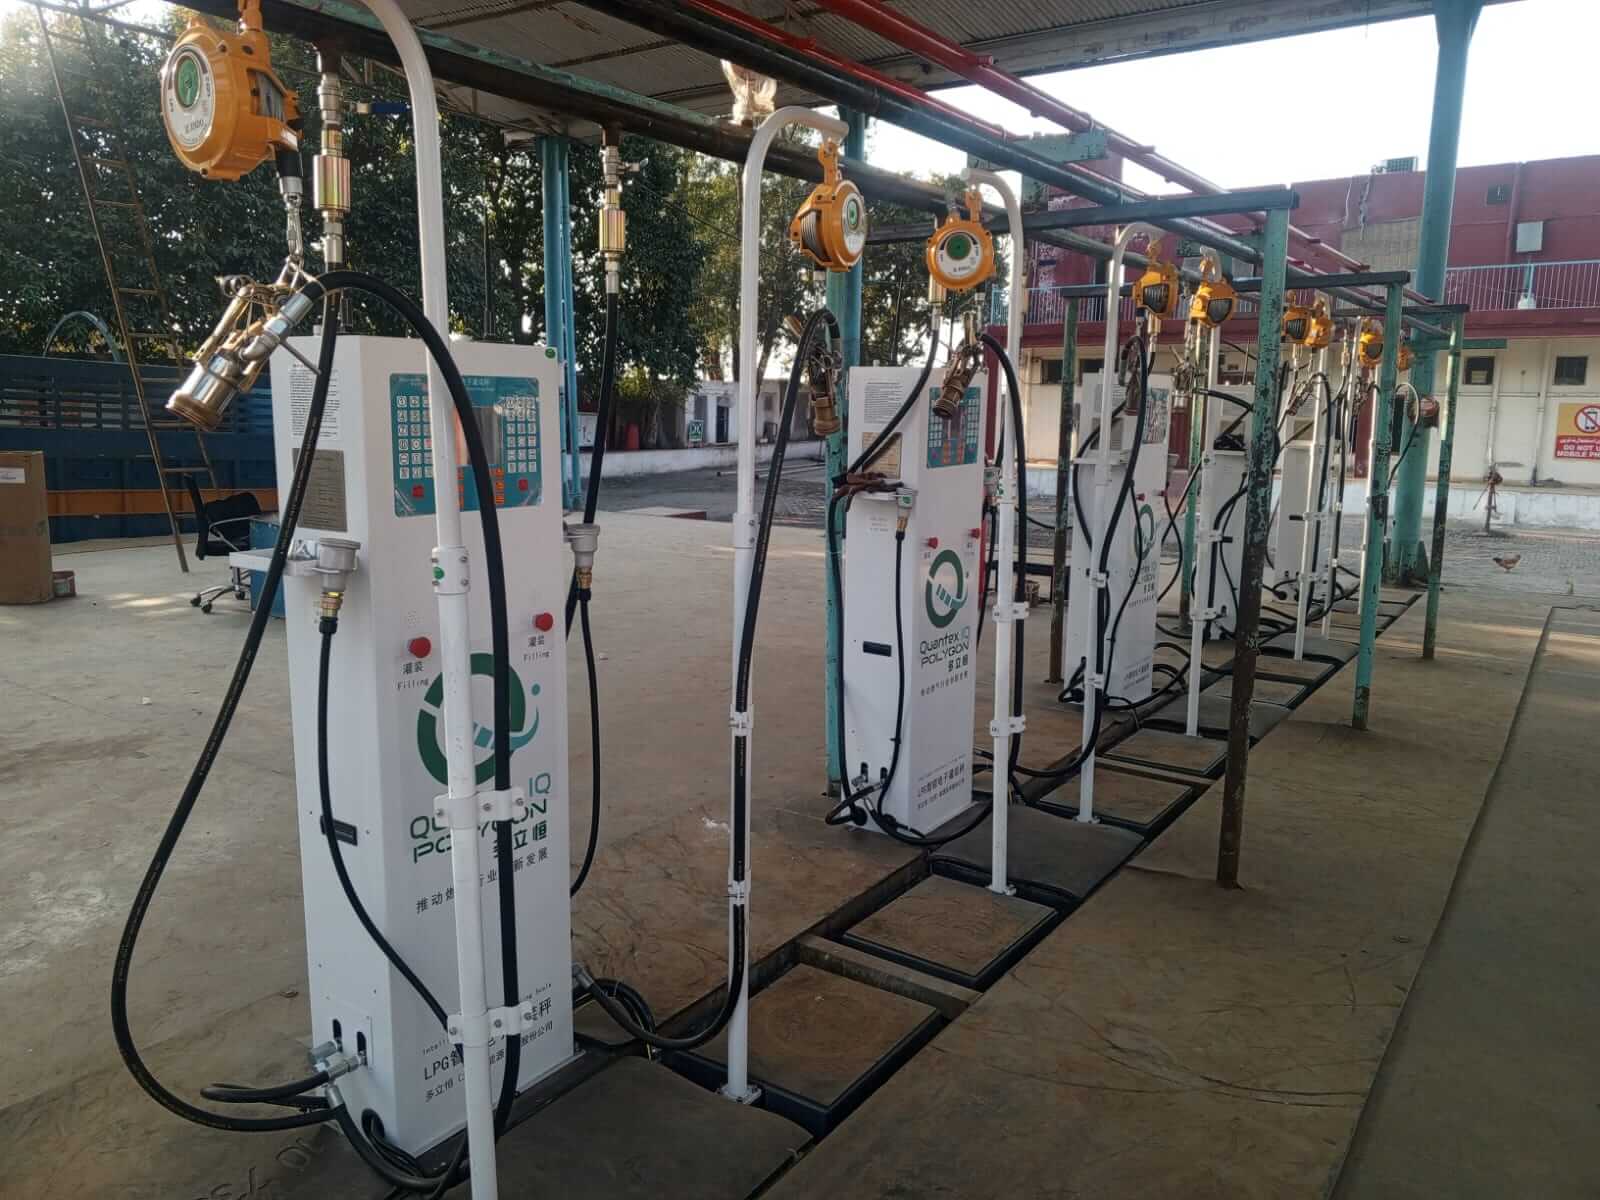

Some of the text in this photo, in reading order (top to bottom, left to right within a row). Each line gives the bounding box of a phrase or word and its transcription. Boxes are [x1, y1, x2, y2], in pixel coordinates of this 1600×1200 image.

[920, 631, 960, 655] Quantex
[921, 641, 969, 669] POLYGON
[523, 650, 551, 662] Filling
[396, 677, 430, 691] Filling
[528, 772, 551, 797] IQ
